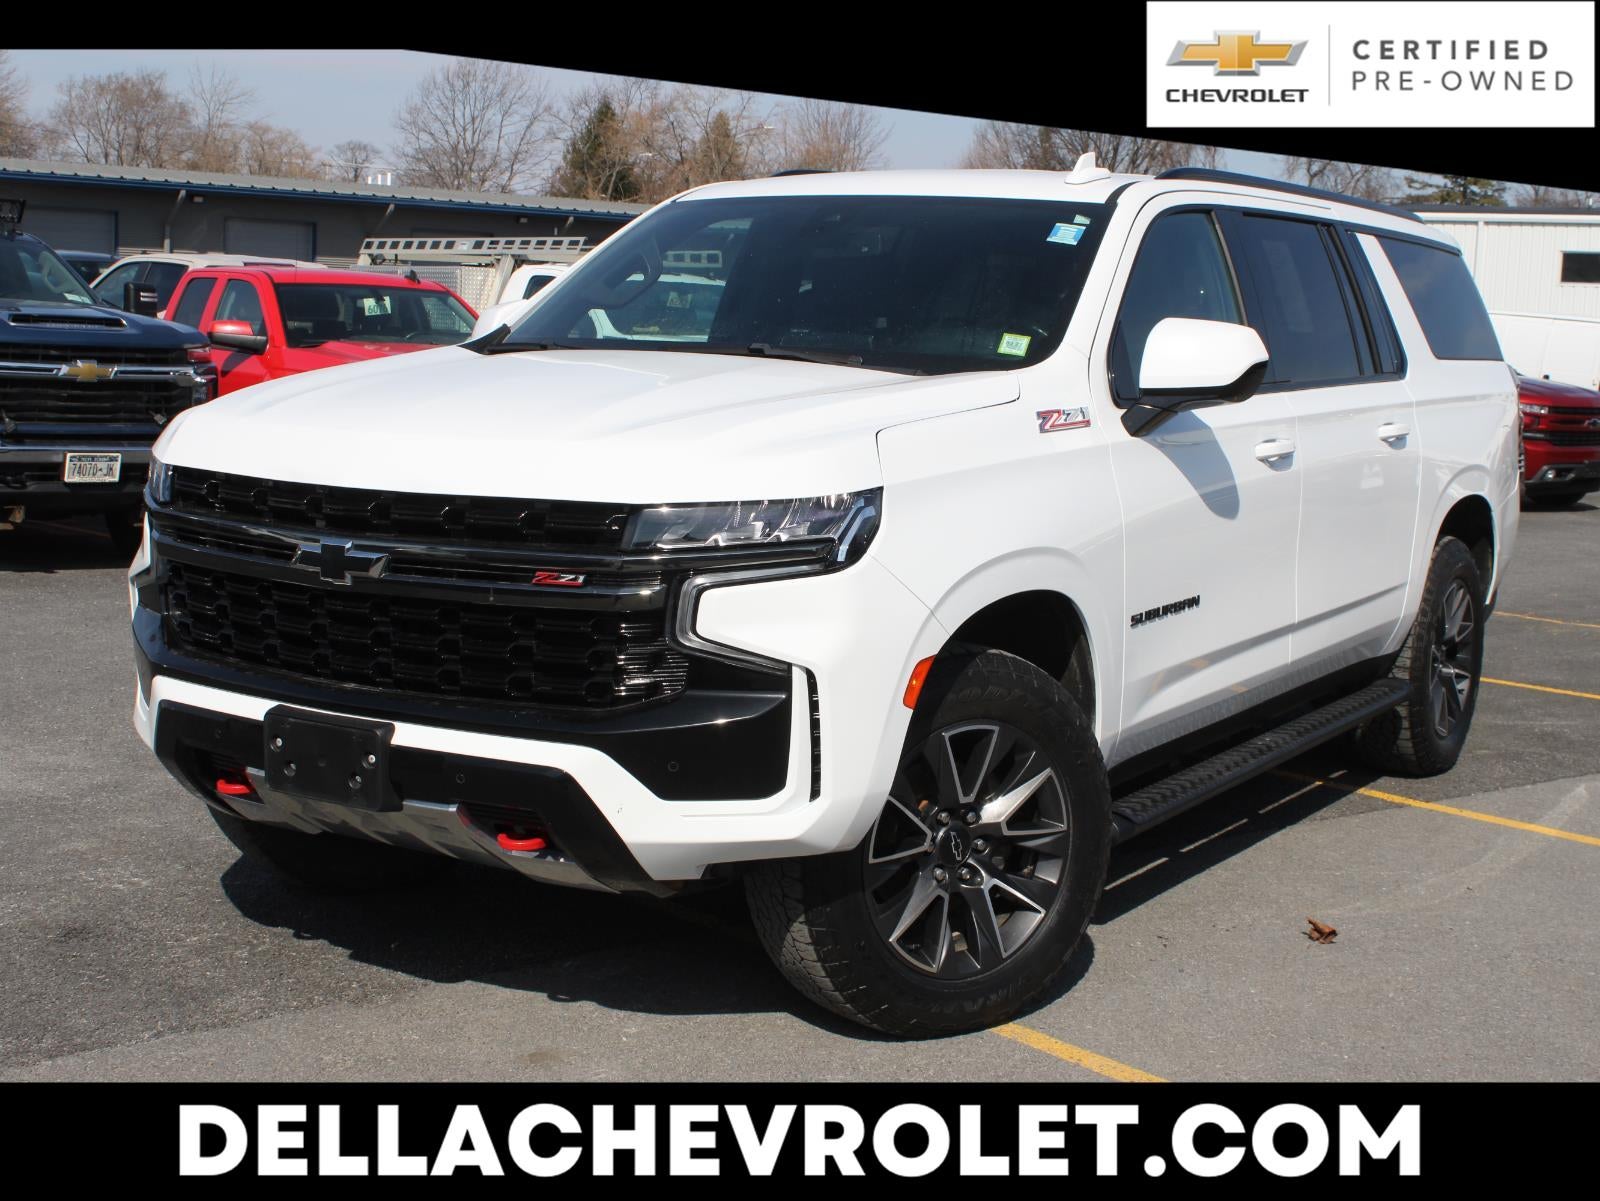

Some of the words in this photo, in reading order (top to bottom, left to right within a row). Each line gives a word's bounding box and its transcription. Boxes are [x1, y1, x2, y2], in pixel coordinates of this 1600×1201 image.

[1036, 406, 1091, 433] Z71
[530, 571, 586, 587] Z71
[1130, 595, 1200, 627] SUBURBAN
